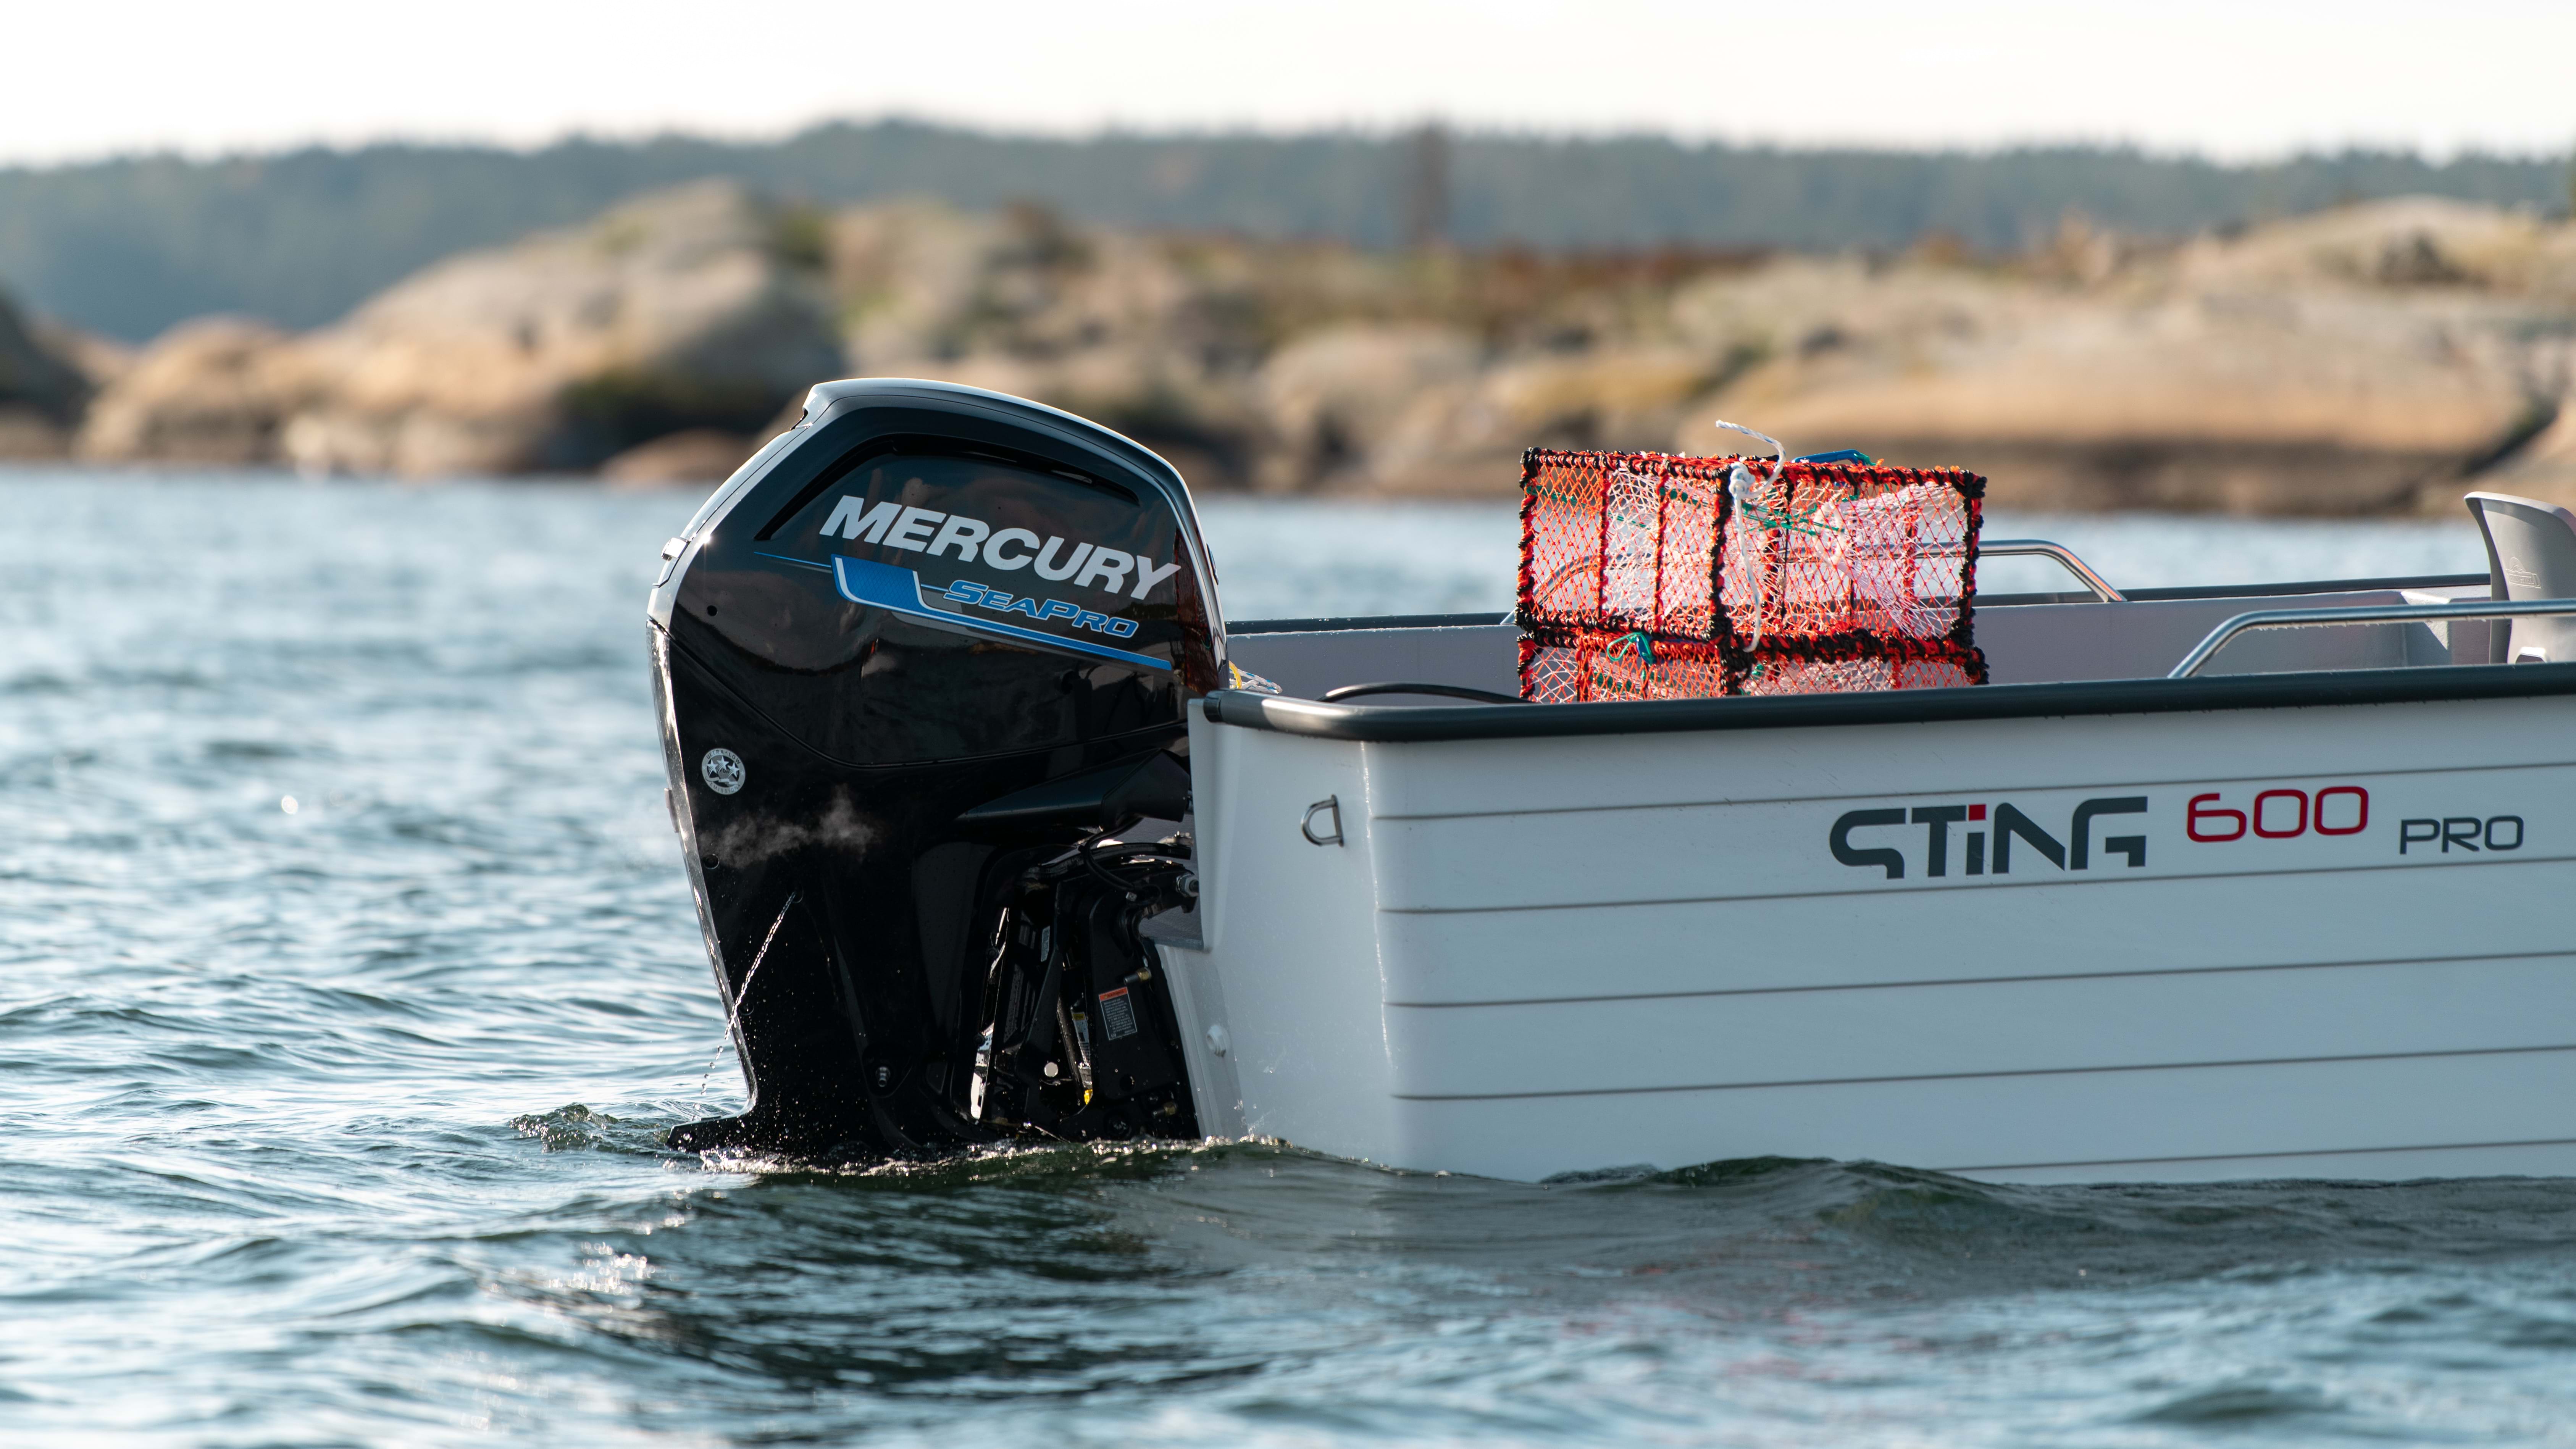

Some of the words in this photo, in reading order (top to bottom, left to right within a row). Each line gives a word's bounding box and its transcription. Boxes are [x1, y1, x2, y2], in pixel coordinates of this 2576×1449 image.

[819, 495, 1181, 600] MERCURY
[706, 749, 724, 759] ULTRA
[728, 752, 741, 765] LOW
[2187, 786, 2369, 843] 600
[2400, 815, 2524, 855] PRO
